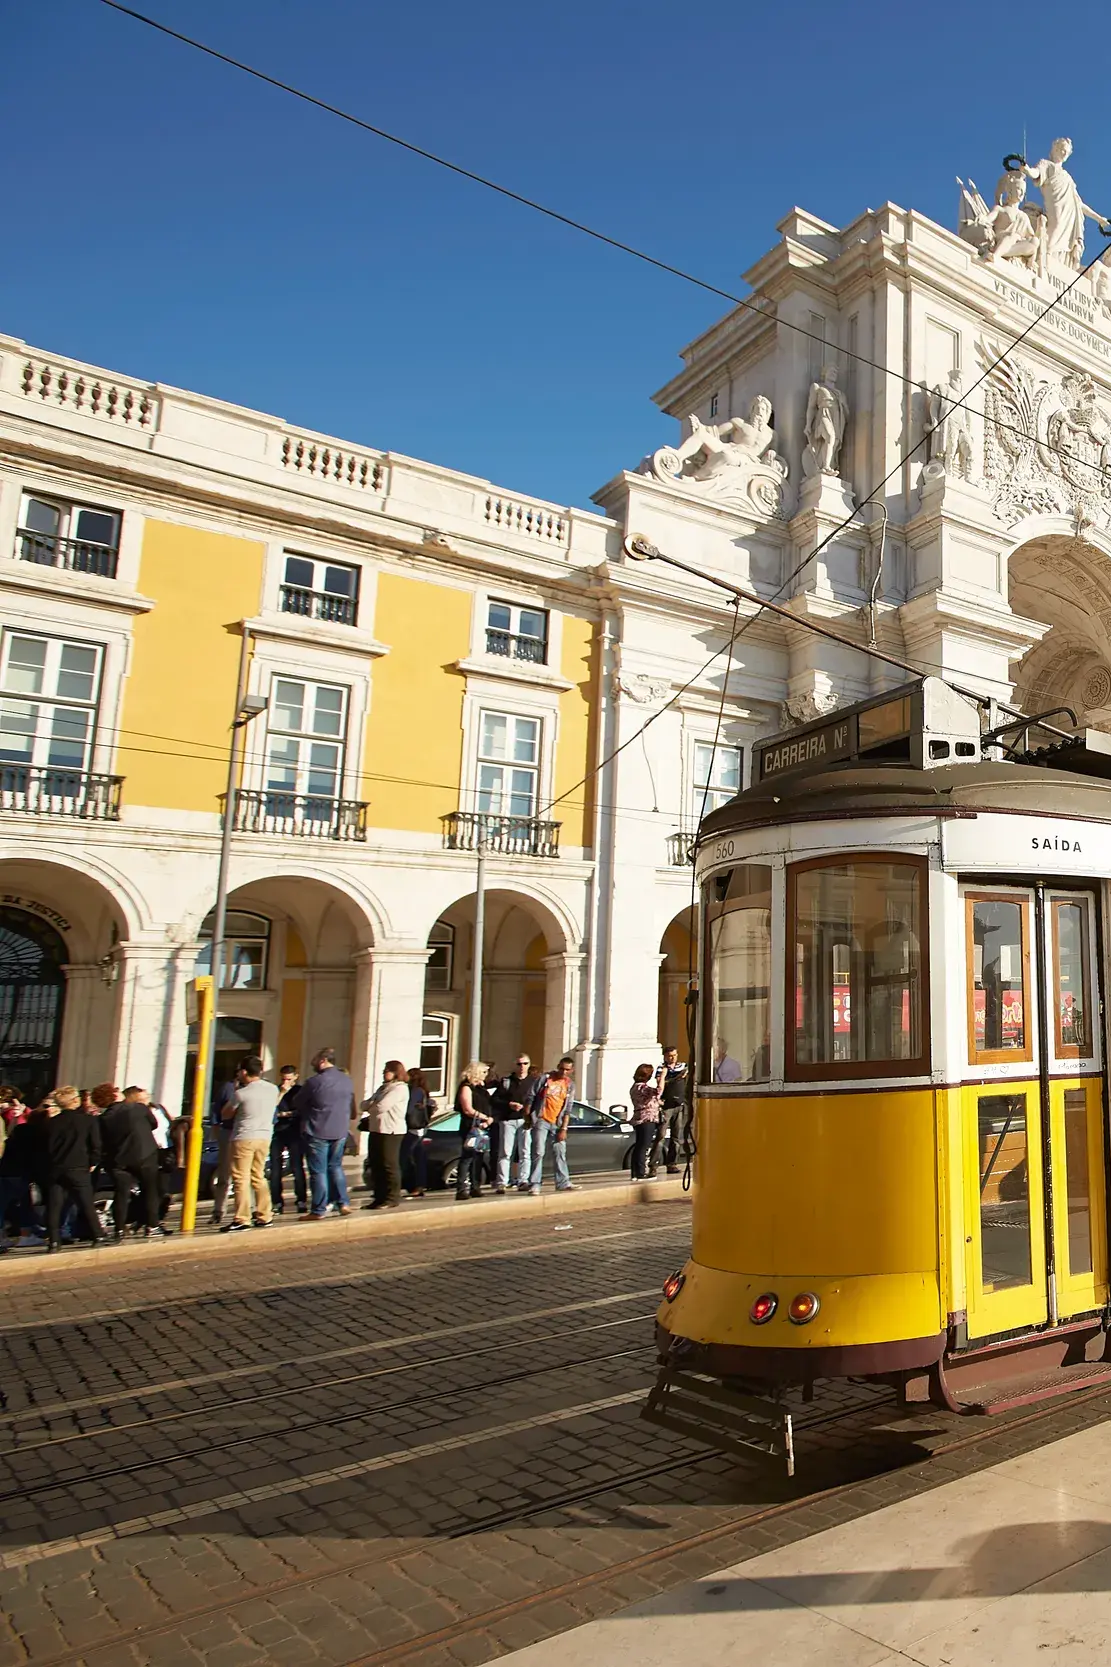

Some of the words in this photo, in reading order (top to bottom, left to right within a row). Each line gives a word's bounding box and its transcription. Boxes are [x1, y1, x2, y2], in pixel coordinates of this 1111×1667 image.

[765, 734, 826, 773] CARREIRA
[716, 840, 735, 859] 560
[1031, 835, 1082, 853] SAÍDA
